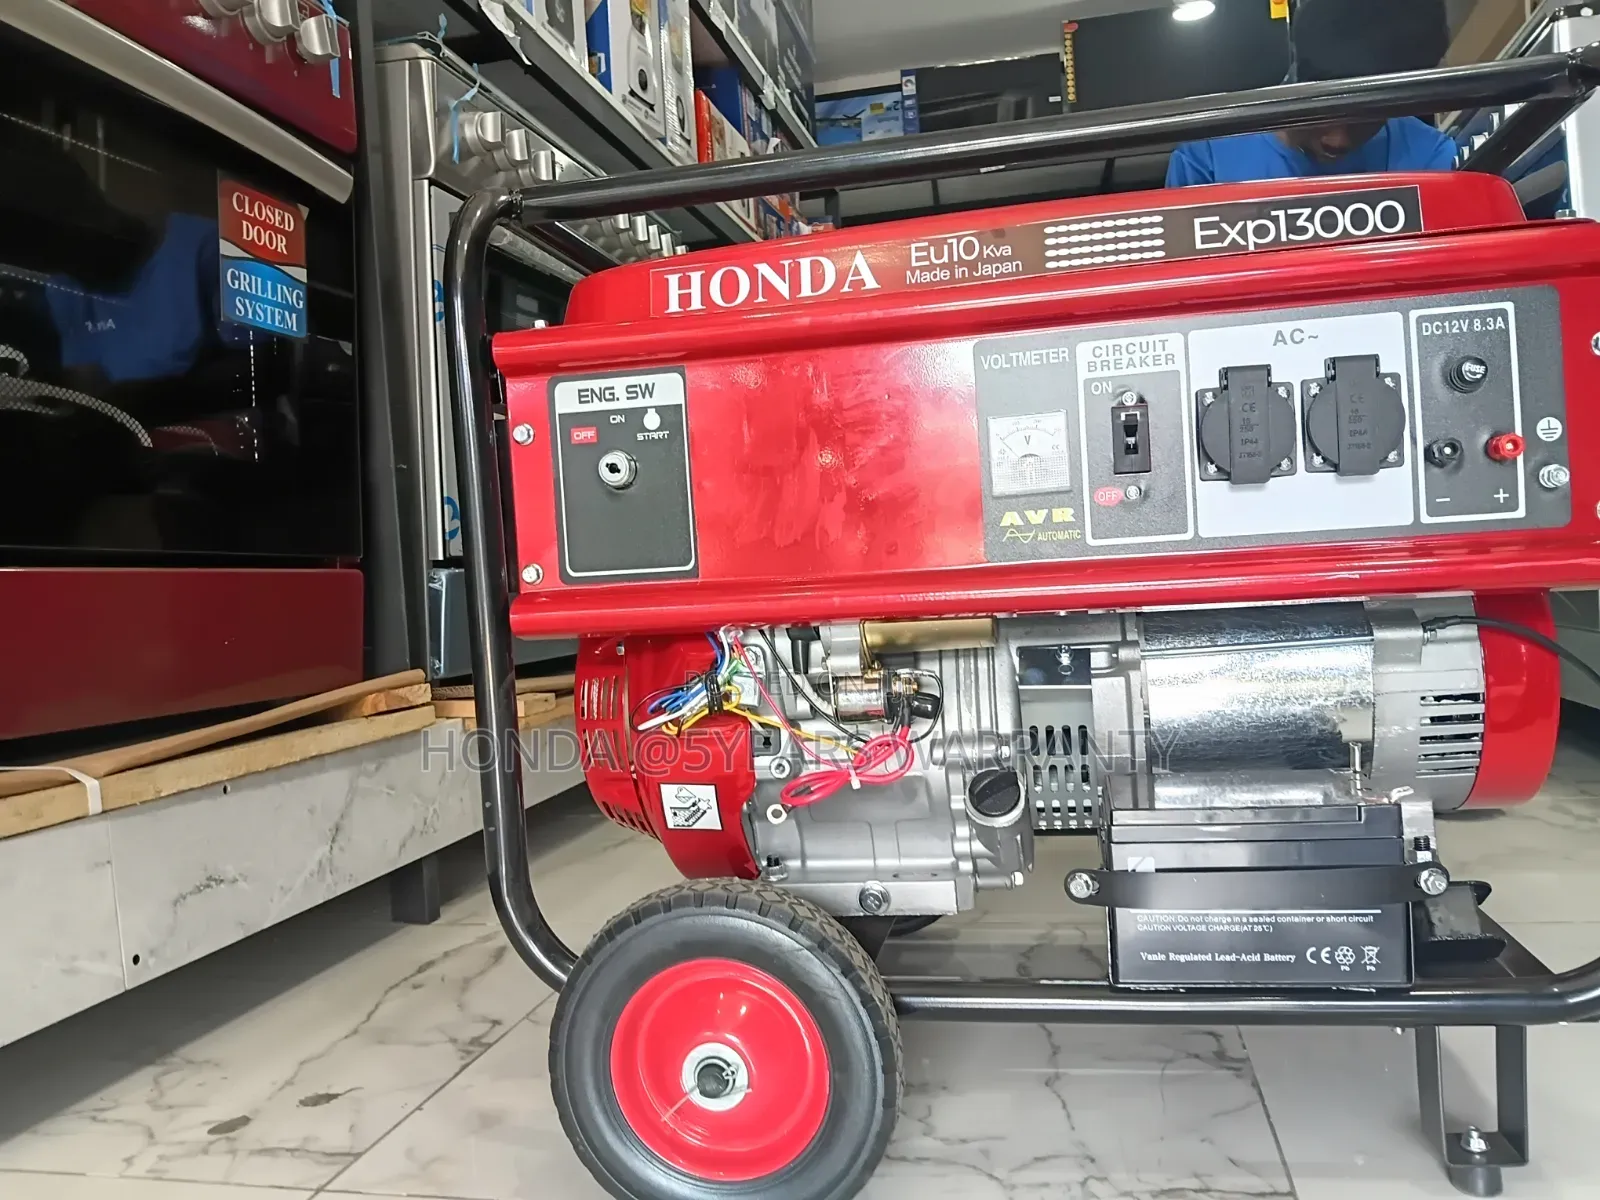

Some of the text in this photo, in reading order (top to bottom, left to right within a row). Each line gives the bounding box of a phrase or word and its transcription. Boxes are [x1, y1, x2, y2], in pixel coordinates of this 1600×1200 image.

[232, 191, 295, 232] CLOSED
[1193, 200, 1406, 251] Exp13000
[241, 219, 288, 255] DOOR
[664, 236, 1012, 314] HONDA Eu10 Kva
[906, 260, 1022, 285] Made in Japan
[226, 267, 304, 309] GRILLING
[235, 296, 298, 332] SYSTEM
[1422, 316, 1506, 336] DC12V 8.3A
[980, 347, 1070, 370] VOLTMETER
[1092, 339, 1169, 359] CIRCUIT
[1087, 353, 1176, 373] BREAKER
[1465, 362, 1486, 374] FUSE
[577, 382, 656, 404] ENG. SW
[1090, 380, 1112, 395] ON
[609, 414, 626, 424] ON
[573, 430, 595, 441] OFF
[636, 430, 670, 441] START
[1024, 435, 1031, 445] V
[1098, 490, 1118, 502] OFF
[1000, 507, 1076, 527] AVR
[1037, 529, 1081, 542] AUTOMATIC
[1137, 924, 1172, 932] CAUTION
[1172, 924, 1207, 932] VOLTAGE
[1190, 915, 1203, 923] not
[1204, 915, 1232, 924] charge
[1233, 915, 1241, 923] in
[1249, 914, 1276, 923] sealed
[1276, 914, 1315, 922] container
[1326, 914, 1348, 922] short
[1349, 914, 1374, 922] circuit
[1169, 951, 1212, 963] Regulated
[1215, 952, 1261, 962] Lead-Acid
[1263, 953, 1296, 964] Battery
